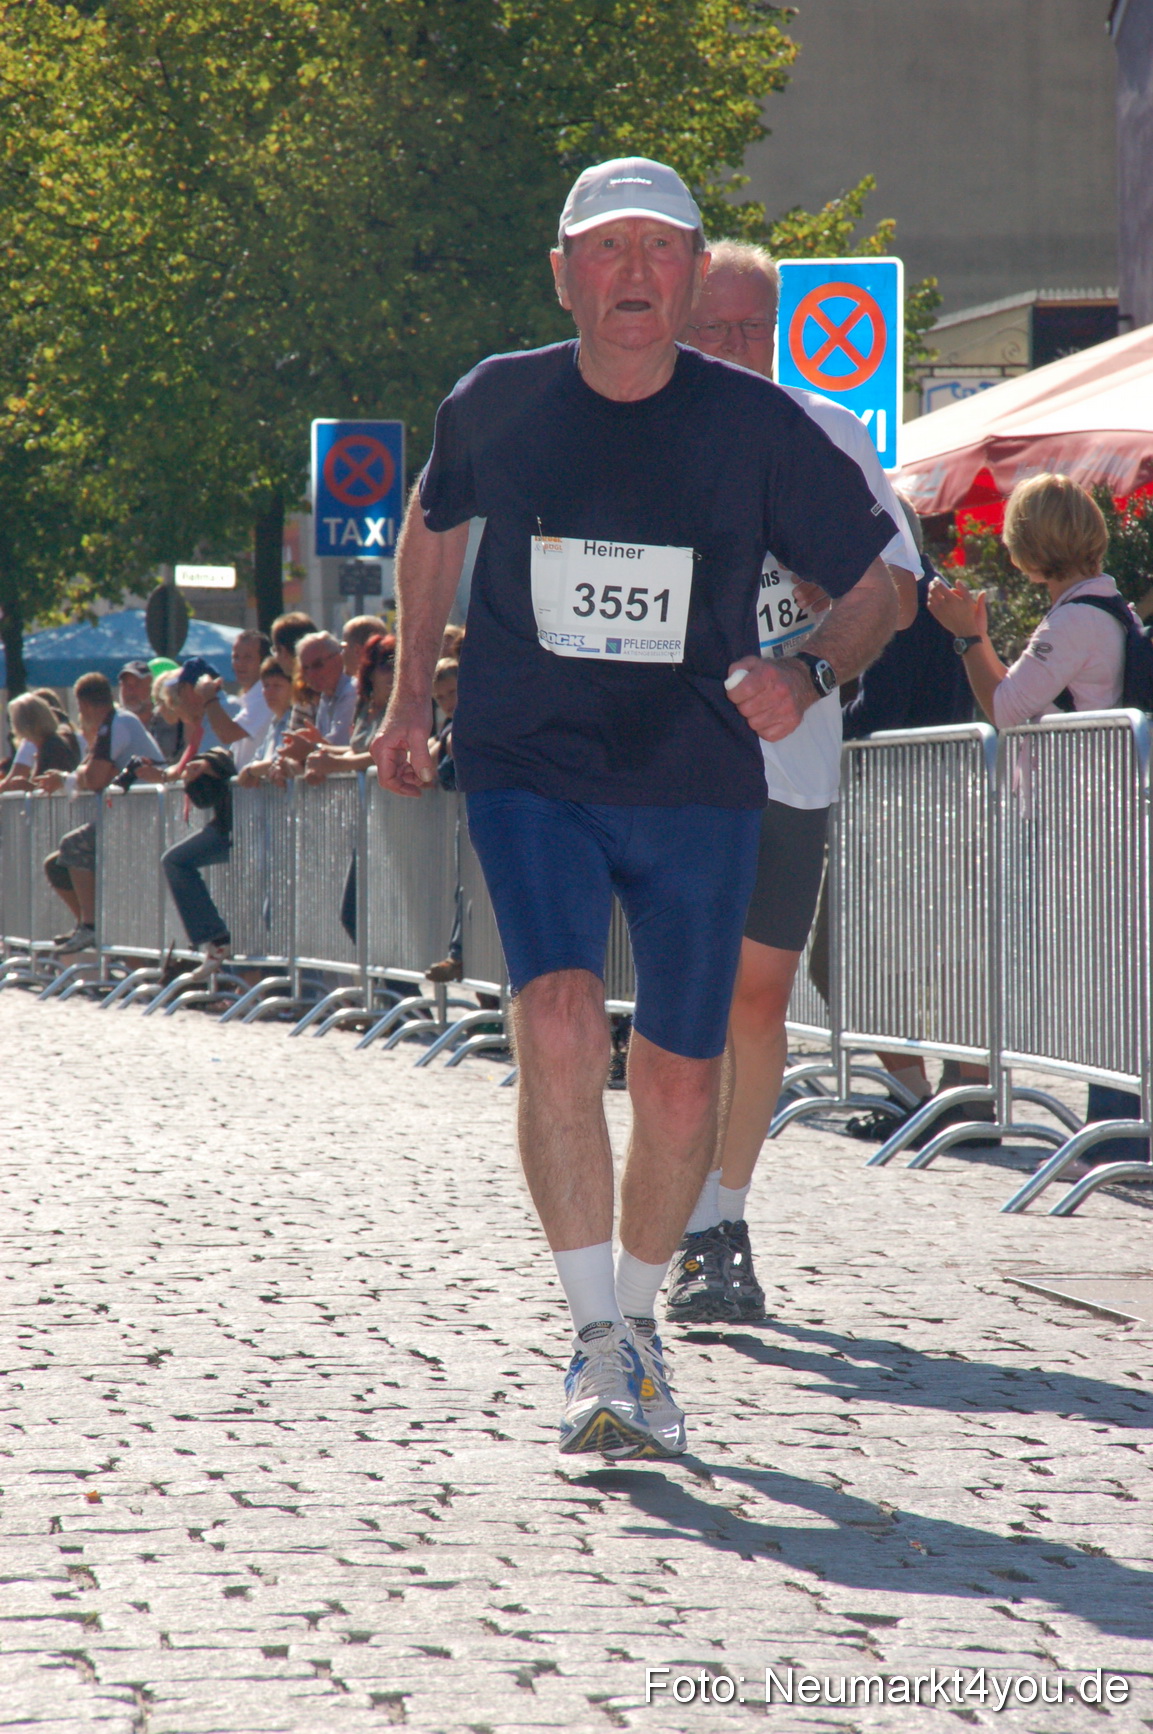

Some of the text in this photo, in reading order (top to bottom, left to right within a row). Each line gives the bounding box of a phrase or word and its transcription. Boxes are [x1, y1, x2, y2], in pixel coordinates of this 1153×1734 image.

[322, 517, 394, 547] TAXI
[583, 540, 645, 560] Heiner
[572, 582, 670, 623] 3551
[623, 638, 681, 650] PFLEIDERER
